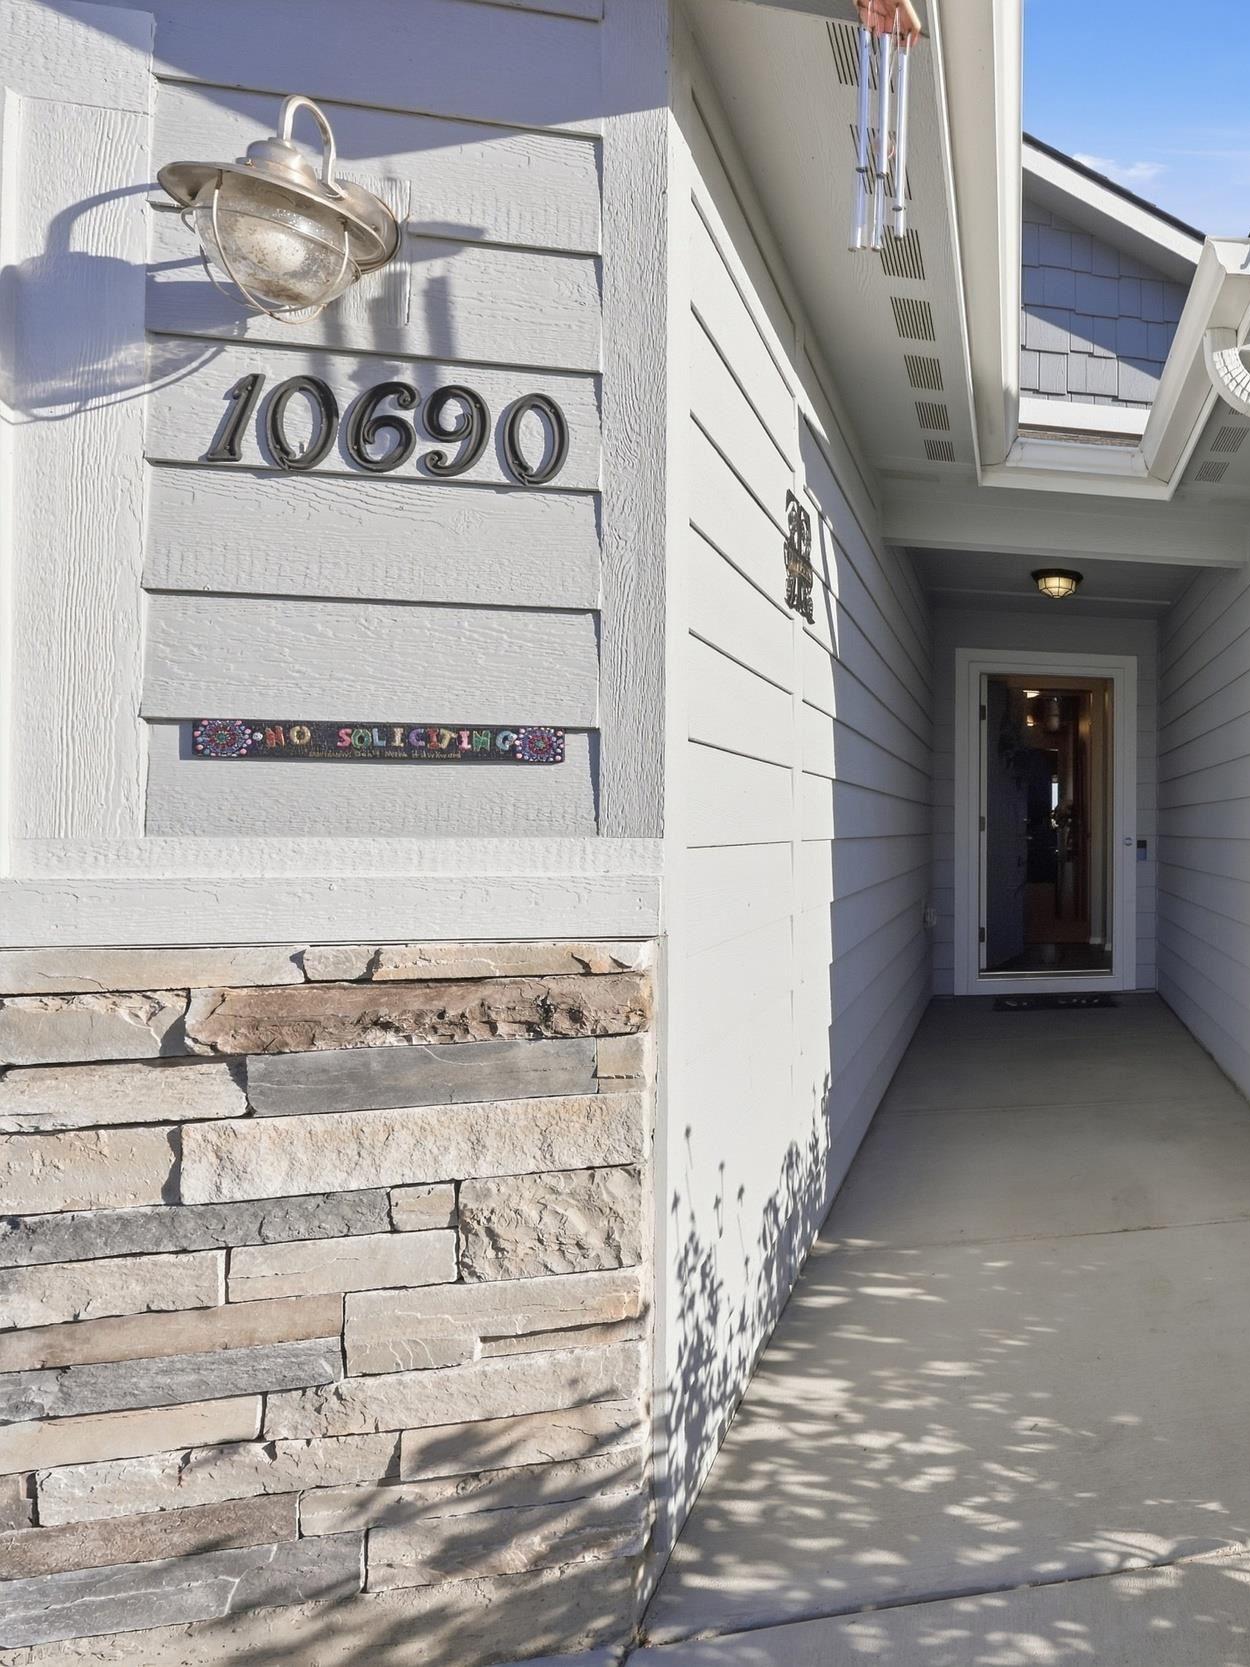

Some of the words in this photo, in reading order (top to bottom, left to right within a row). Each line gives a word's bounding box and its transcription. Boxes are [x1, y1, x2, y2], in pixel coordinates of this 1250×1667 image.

[206, 372, 570, 486] 10690
[264, 725, 312, 747] NO
[336, 727, 518, 751] SOLICITING
